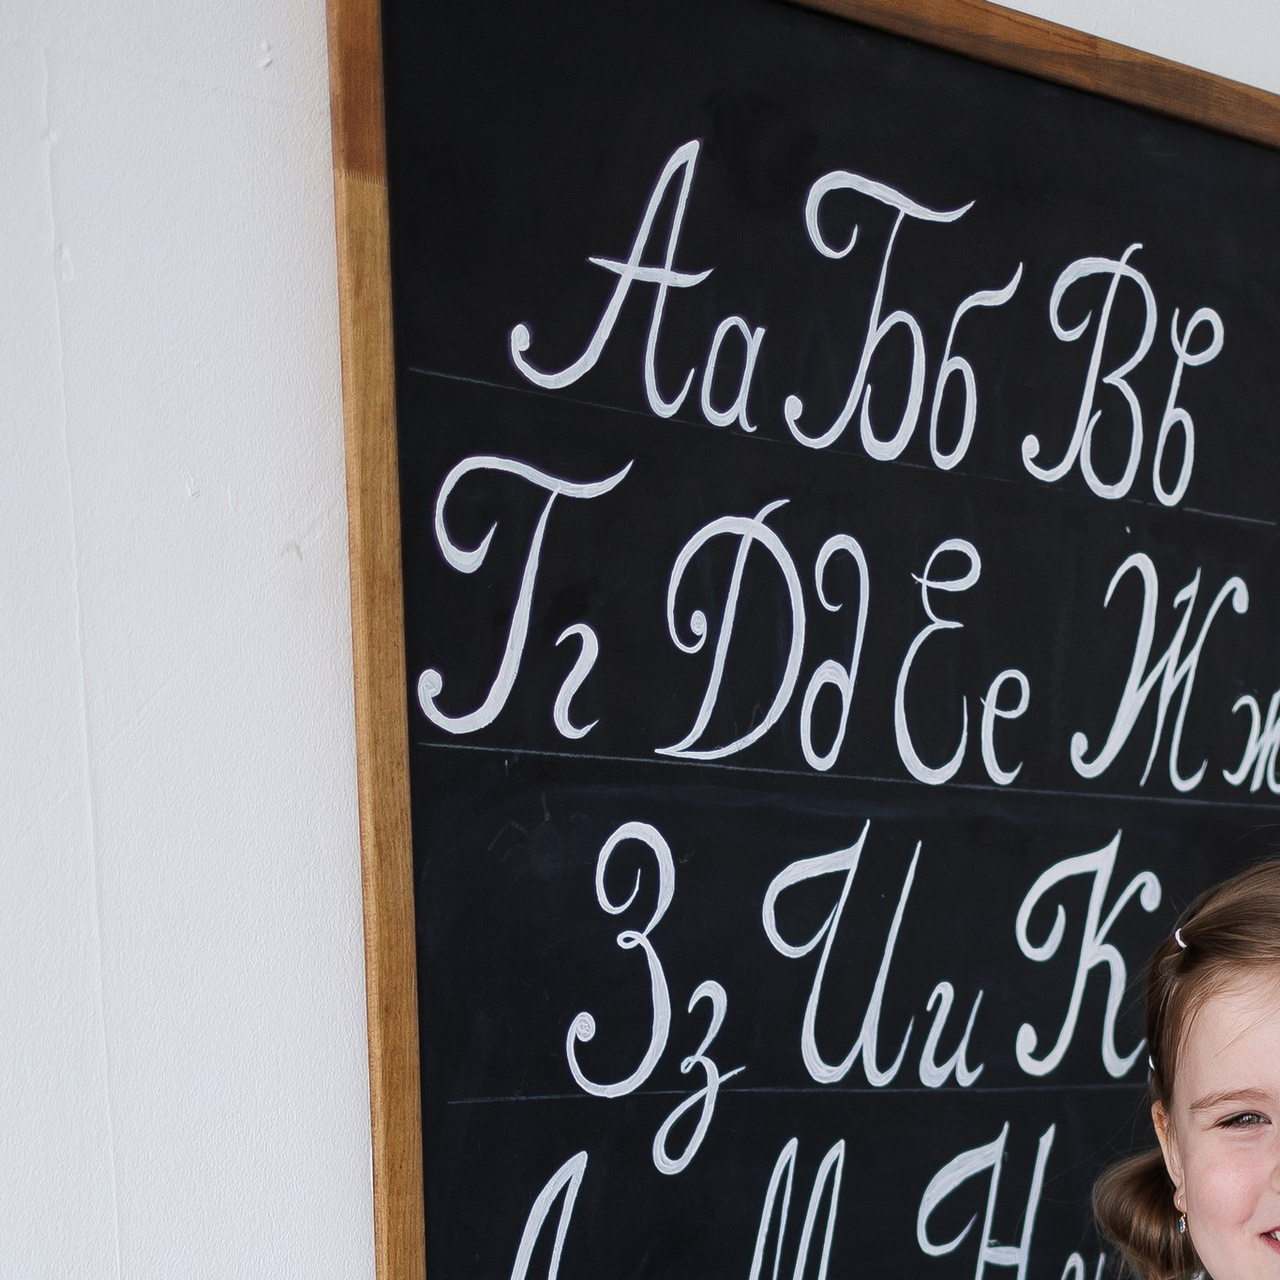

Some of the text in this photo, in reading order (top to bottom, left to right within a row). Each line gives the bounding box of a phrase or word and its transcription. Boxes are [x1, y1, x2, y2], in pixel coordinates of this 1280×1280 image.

[509, 138, 1225, 507] Аа Бб Вв
[417, 455, 634, 740] Гг
[654, 498, 870, 772] Дд
[894, 538, 1031, 786] Ее
[565, 821, 747, 1176] Зз
[761, 818, 985, 1089] Ии
